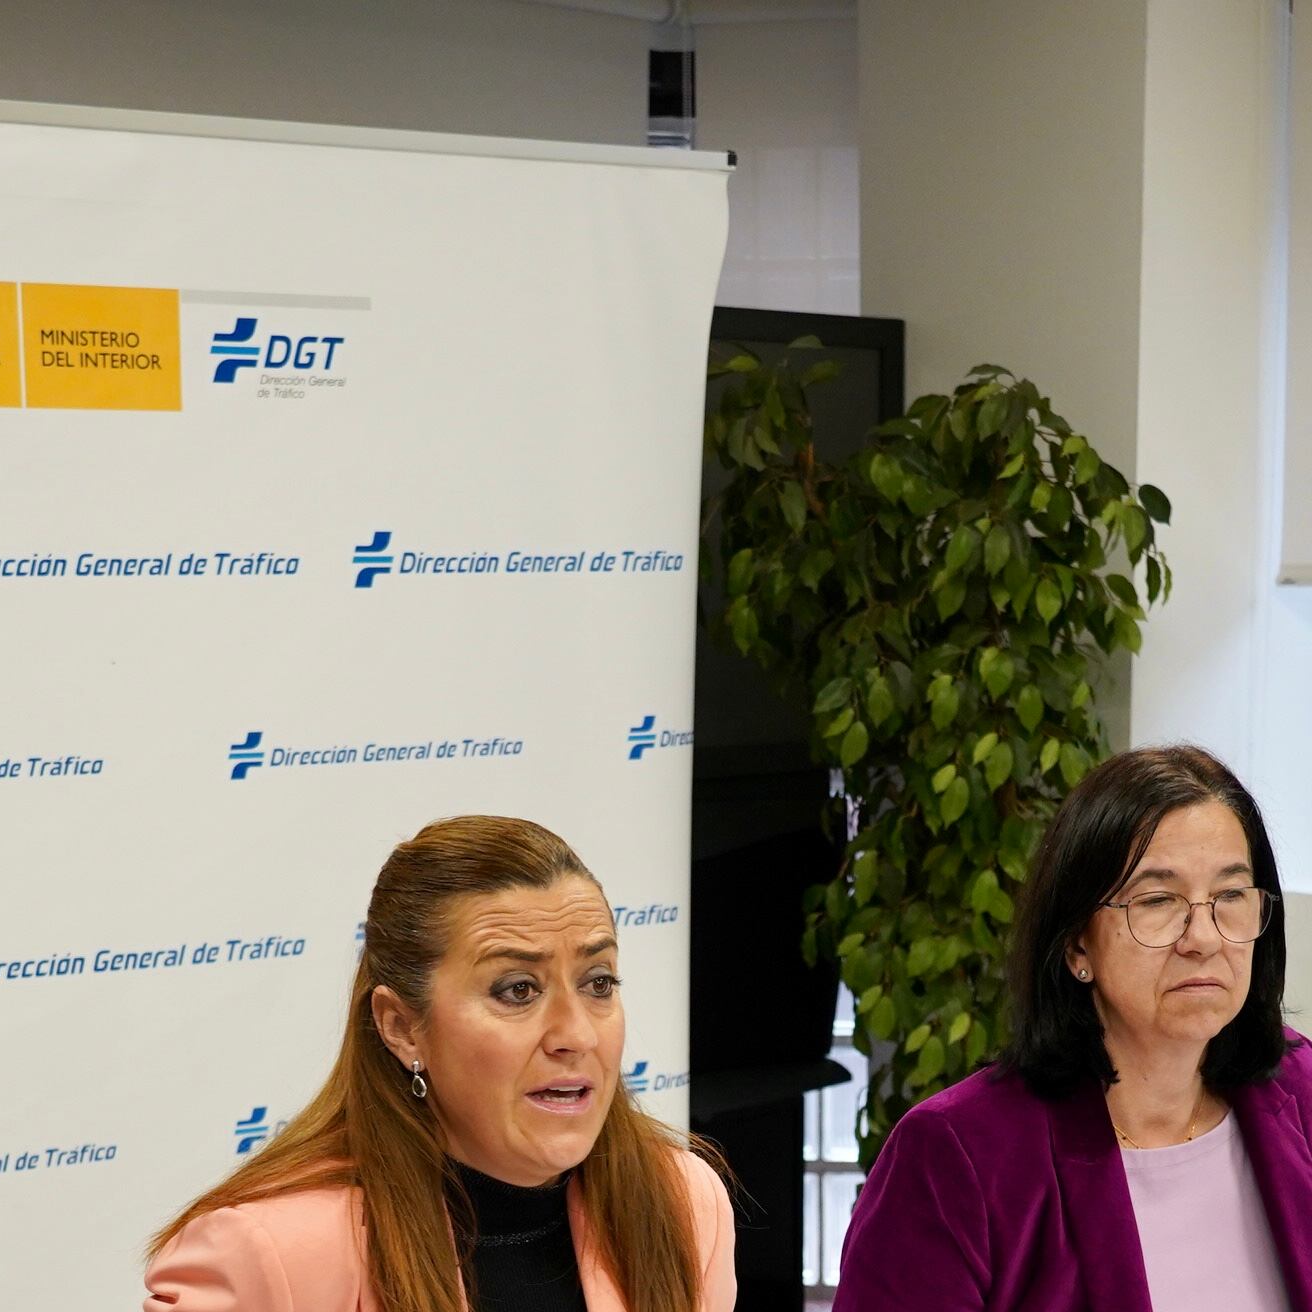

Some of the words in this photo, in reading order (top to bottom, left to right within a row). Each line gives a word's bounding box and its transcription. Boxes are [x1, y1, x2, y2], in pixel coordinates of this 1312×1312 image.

[40, 330, 140, 348] MINISTERIO
[42, 351, 74, 367] DEL
[80, 353, 161, 369] INTERIOR
[264, 335, 344, 370] DGT
[76, 554, 172, 576] General
[179, 554, 207, 575] de
[215, 553, 299, 575] Tráfico
[400, 552, 499, 573] Dirección
[506, 552, 585, 572] General
[590, 552, 616, 572] de
[622, 551, 683, 571] Tráfico
[270, 748, 357, 766] Dirección
[363, 742, 432, 762] General
[436, 741, 457, 758] de
[462, 738, 523, 756] Tráfico
[28, 757, 103, 776] Tráfico
[614, 905, 678, 927] Tráfico
[94, 945, 186, 972] General
[192, 943, 219, 964] de
[227, 937, 305, 961] Tráfico
[15, 1152, 39, 1171] de
[46, 1145, 116, 1167] Tráfico
